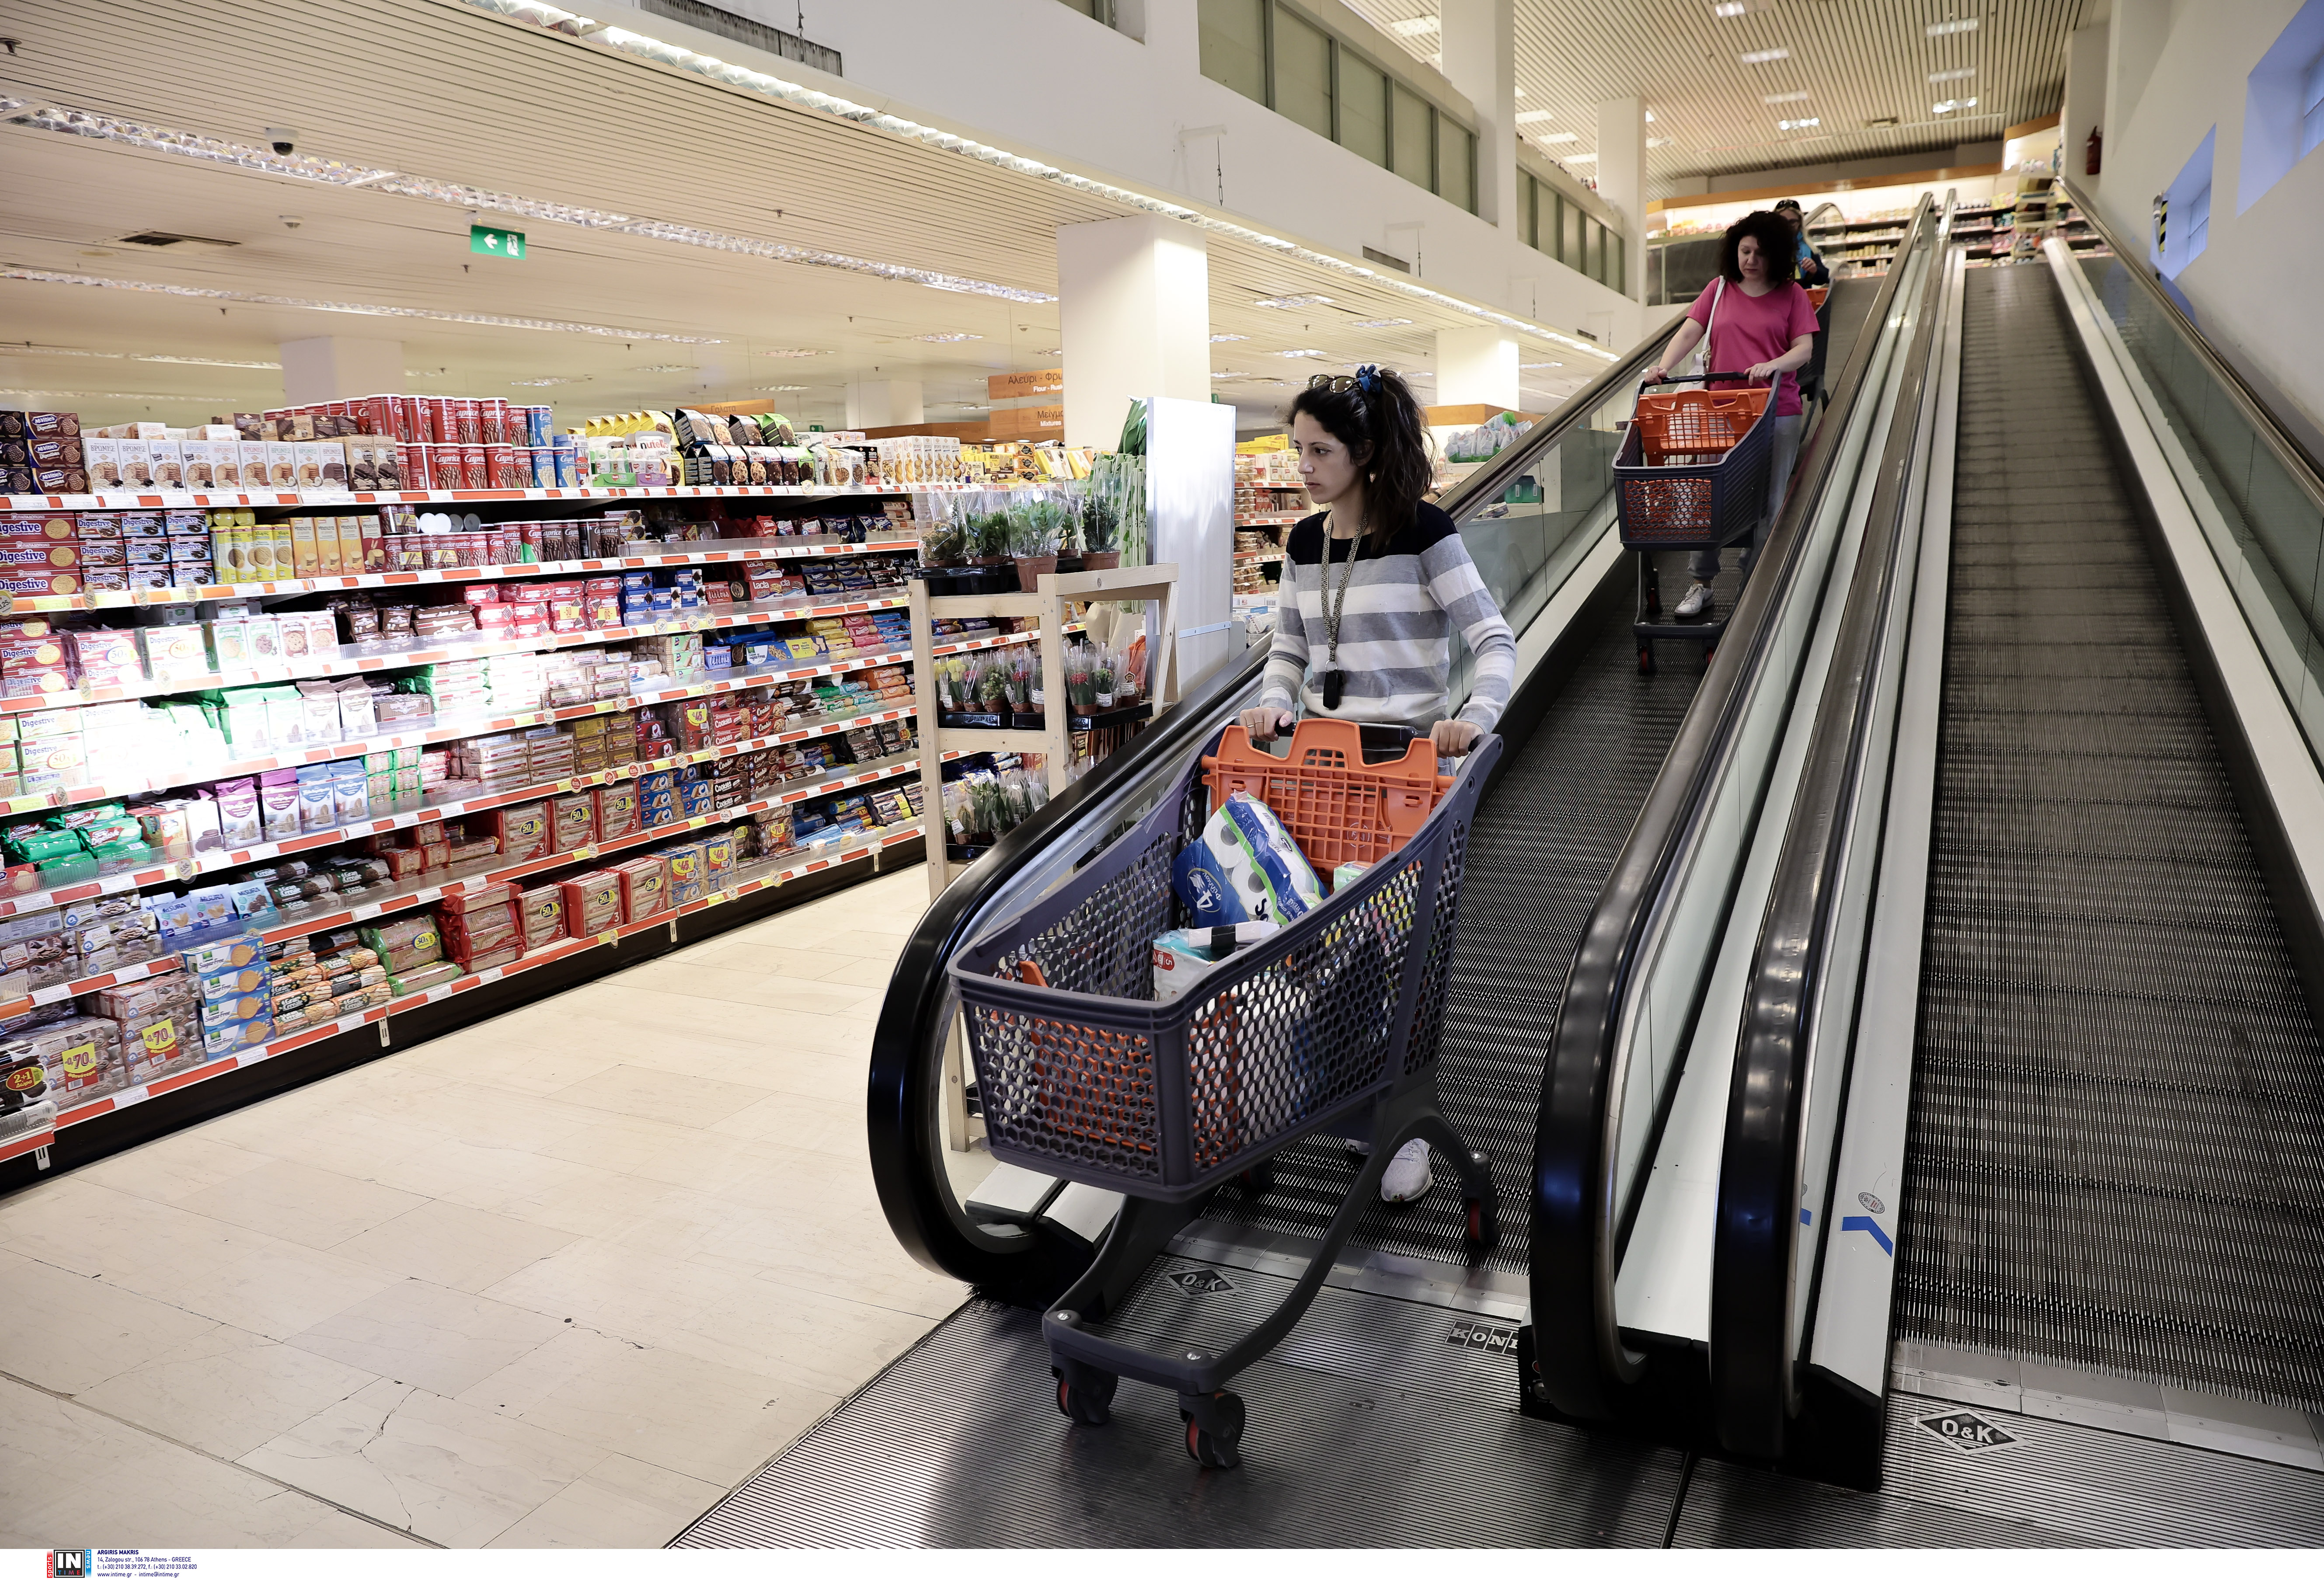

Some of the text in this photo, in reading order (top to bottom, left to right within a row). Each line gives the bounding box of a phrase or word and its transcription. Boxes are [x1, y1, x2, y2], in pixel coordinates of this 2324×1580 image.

[1008, 375, 1037, 385] Αλεύρι
[1045, 372, 1062, 383] Φρυ
[1038, 409, 1063, 419] Μείγμα
[464, 454, 485, 463] Capri
[495, 454, 514, 463] Capri
[0, 522, 40, 534] igestive
[0, 578, 46, 591] Digestive
[753, 580, 770, 589] Lacta
[150, 635, 179, 644] Digestive
[80, 642, 112, 650] Digestive
[3, 648, 38, 658] Digestive
[757, 705, 770, 716] Cookie
[21, 717, 55, 727] Digestive
[714, 718, 732, 728] Cookies
[758, 721, 772, 731] Cookie
[715, 734, 733, 745] Cookies
[25, 745, 57, 755] Digestive
[754, 752, 766, 762] Cookie
[718, 758, 734, 769] Cookie
[755, 768, 767, 778] Cookie
[714, 781, 732, 792] Cookies
[716, 797, 733, 809] Cookies
[631, 819, 636, 829] 3
[589, 830, 593, 840] 3
[539, 843, 544, 853] 3
[1203, 872, 1221, 901] Φύλλων
[658, 898, 663, 908] 3
[1197, 889, 1213, 908] 4
[614, 912, 620, 922] 3
[558, 925, 564, 935] 3
[4, 950, 24, 960] Goody
[199, 961, 214, 969] Sugar
[206, 987, 221, 995] Sugar
[205, 1013, 220, 1022] Sugar
[13, 1071, 32, 1084] 2+1
[1181, 1273, 1220, 1292] O&K
[1941, 1418, 1994, 1444] O&K
